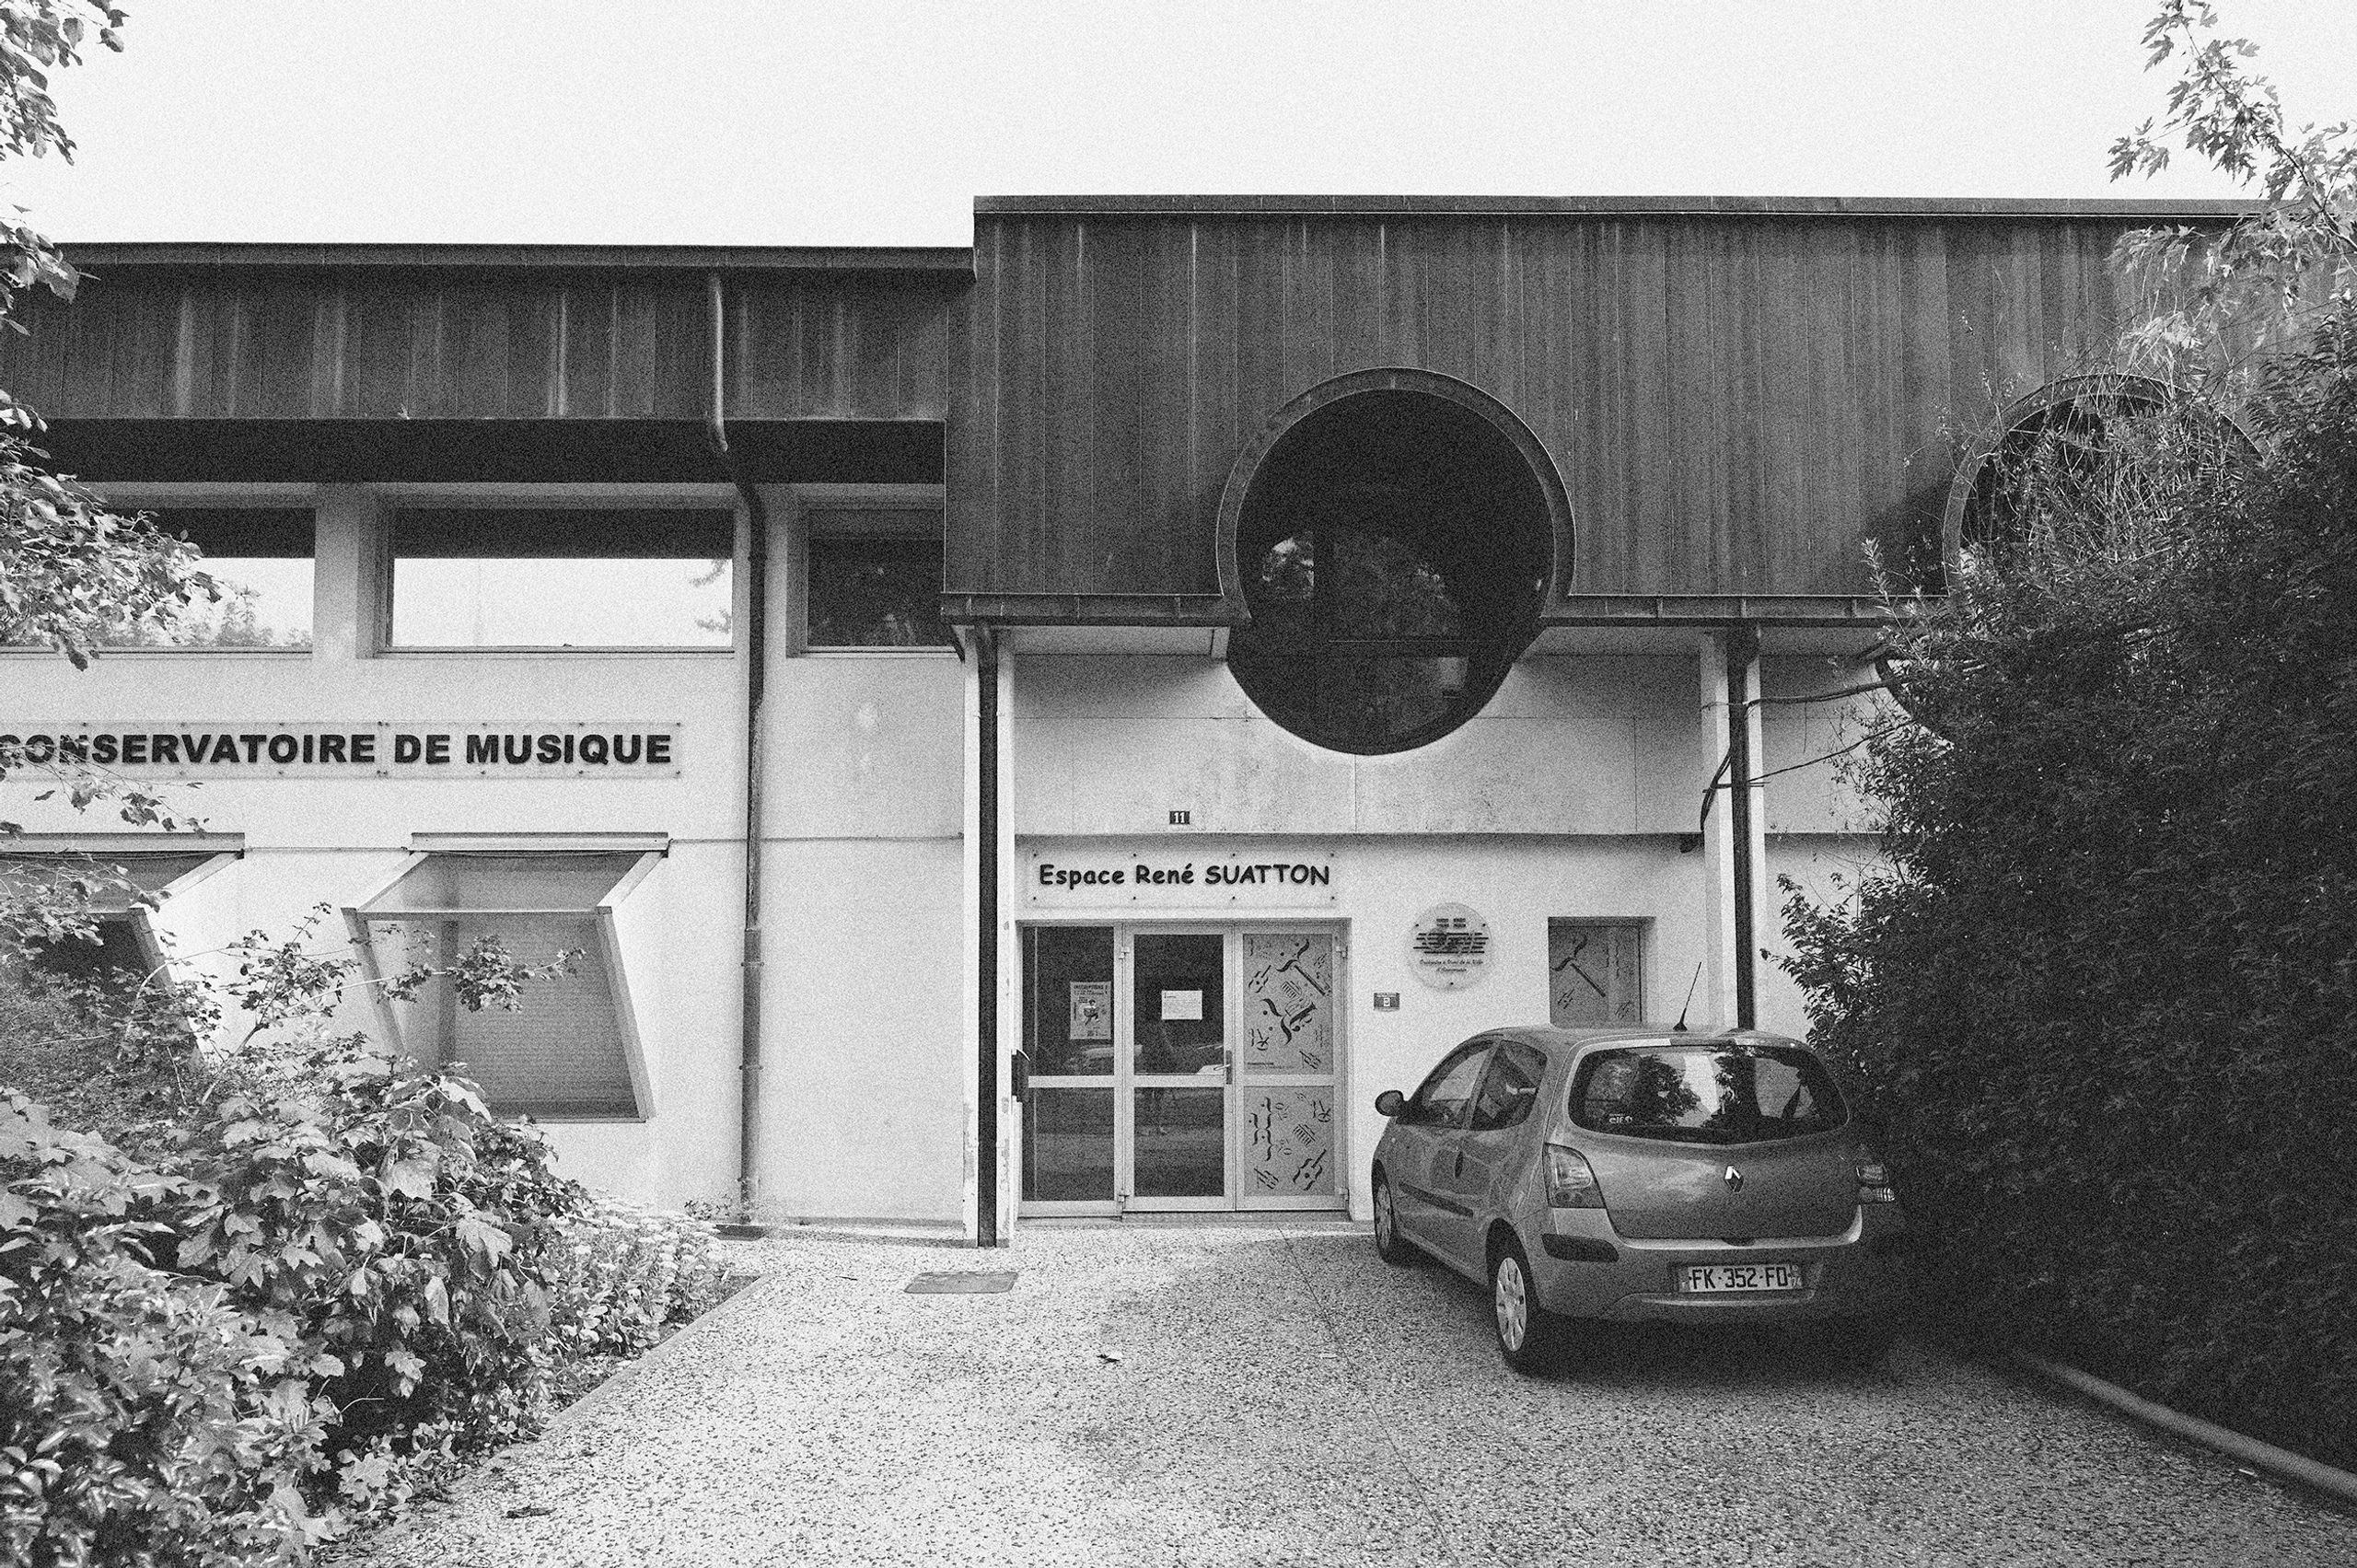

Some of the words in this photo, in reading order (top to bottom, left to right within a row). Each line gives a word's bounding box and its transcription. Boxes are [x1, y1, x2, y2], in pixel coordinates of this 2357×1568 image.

[0, 734, 375, 764] CONSERVATOIRE
[394, 734, 451, 764] DE
[466, 734, 671, 765] MUSIQUE
[1174, 812, 1185, 823] 11
[1039, 864, 1125, 890] Espace
[1135, 862, 1195, 885] René
[1204, 864, 1330, 885] SUATTON
